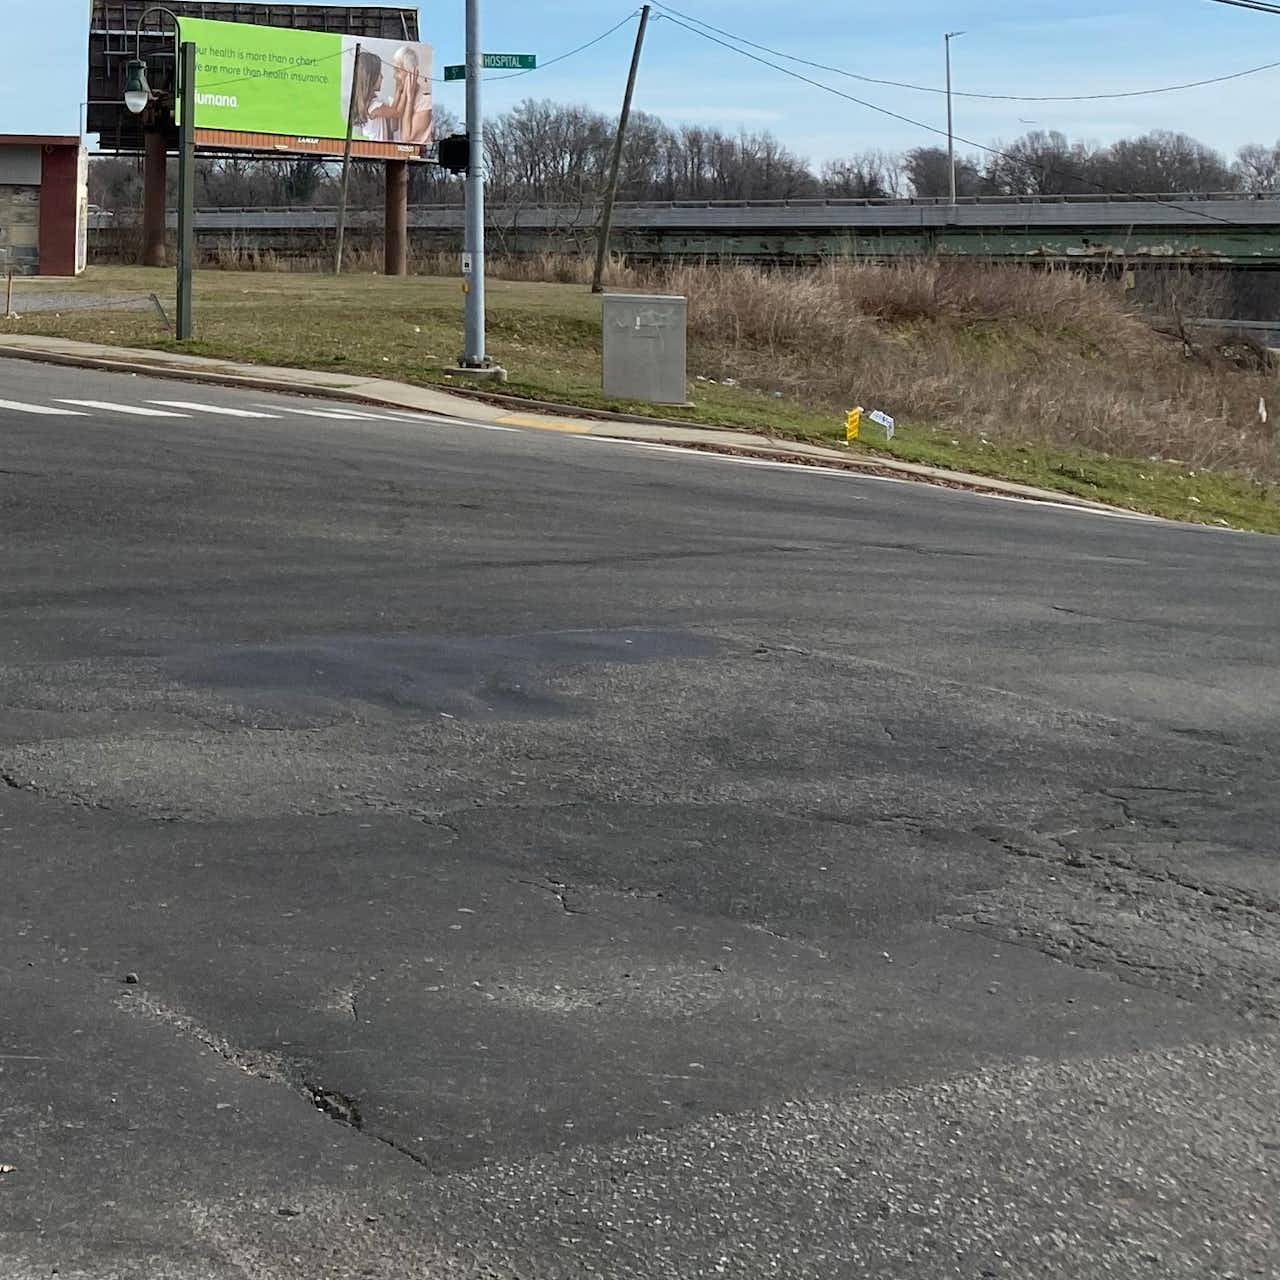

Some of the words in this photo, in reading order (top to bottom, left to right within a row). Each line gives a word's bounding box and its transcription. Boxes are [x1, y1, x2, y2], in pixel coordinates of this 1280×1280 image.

[210, 47, 235, 58] health
[238, 51, 244, 60] is
[246, 53, 267, 62] more
[269, 52, 286, 63] than
[289, 56, 294, 64] a
[484, 55, 522, 68] HOSPITAL
[205, 64, 218, 73] are
[220, 66, 240, 75] more
[243, 66, 261, 77] than
[264, 68, 289, 79] health
